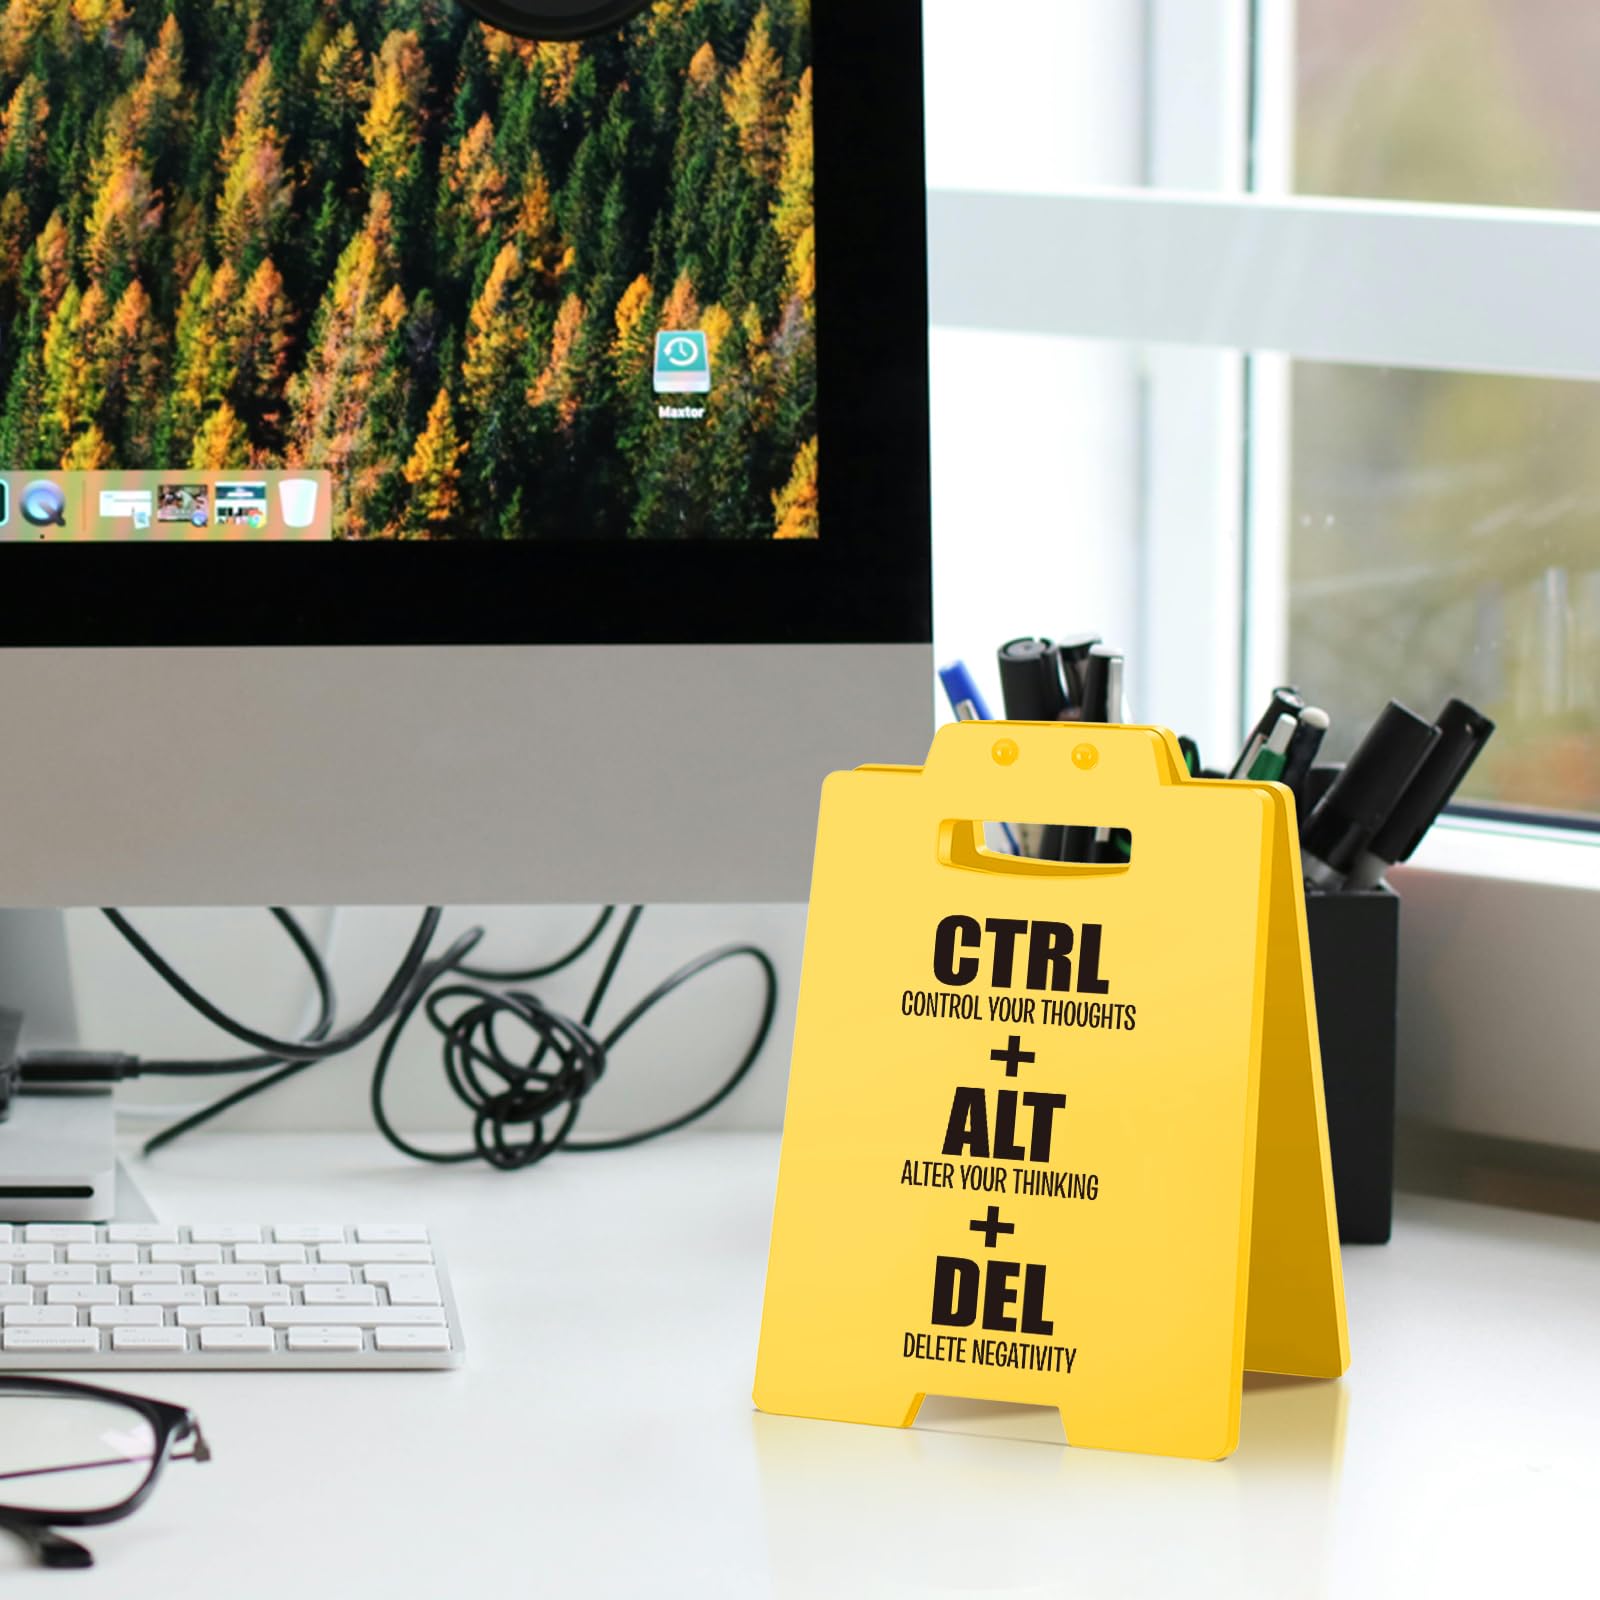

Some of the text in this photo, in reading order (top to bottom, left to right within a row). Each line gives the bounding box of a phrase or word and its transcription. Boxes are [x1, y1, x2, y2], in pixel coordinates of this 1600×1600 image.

[658, 405, 705, 419] Maxtor
[933, 914, 1109, 994] CTRL
[901, 990, 1137, 1031] CONTROL YOUR THOUGHTS
[990, 1036, 1035, 1077] +
[942, 1086, 1067, 1162] ALT
[901, 1159, 1098, 1201] ALTER YOUR THINKING
[969, 1205, 1014, 1247] +
[931, 1255, 1054, 1335] DEL
[904, 1332, 1077, 1374] DELETE NEGATIVITY
